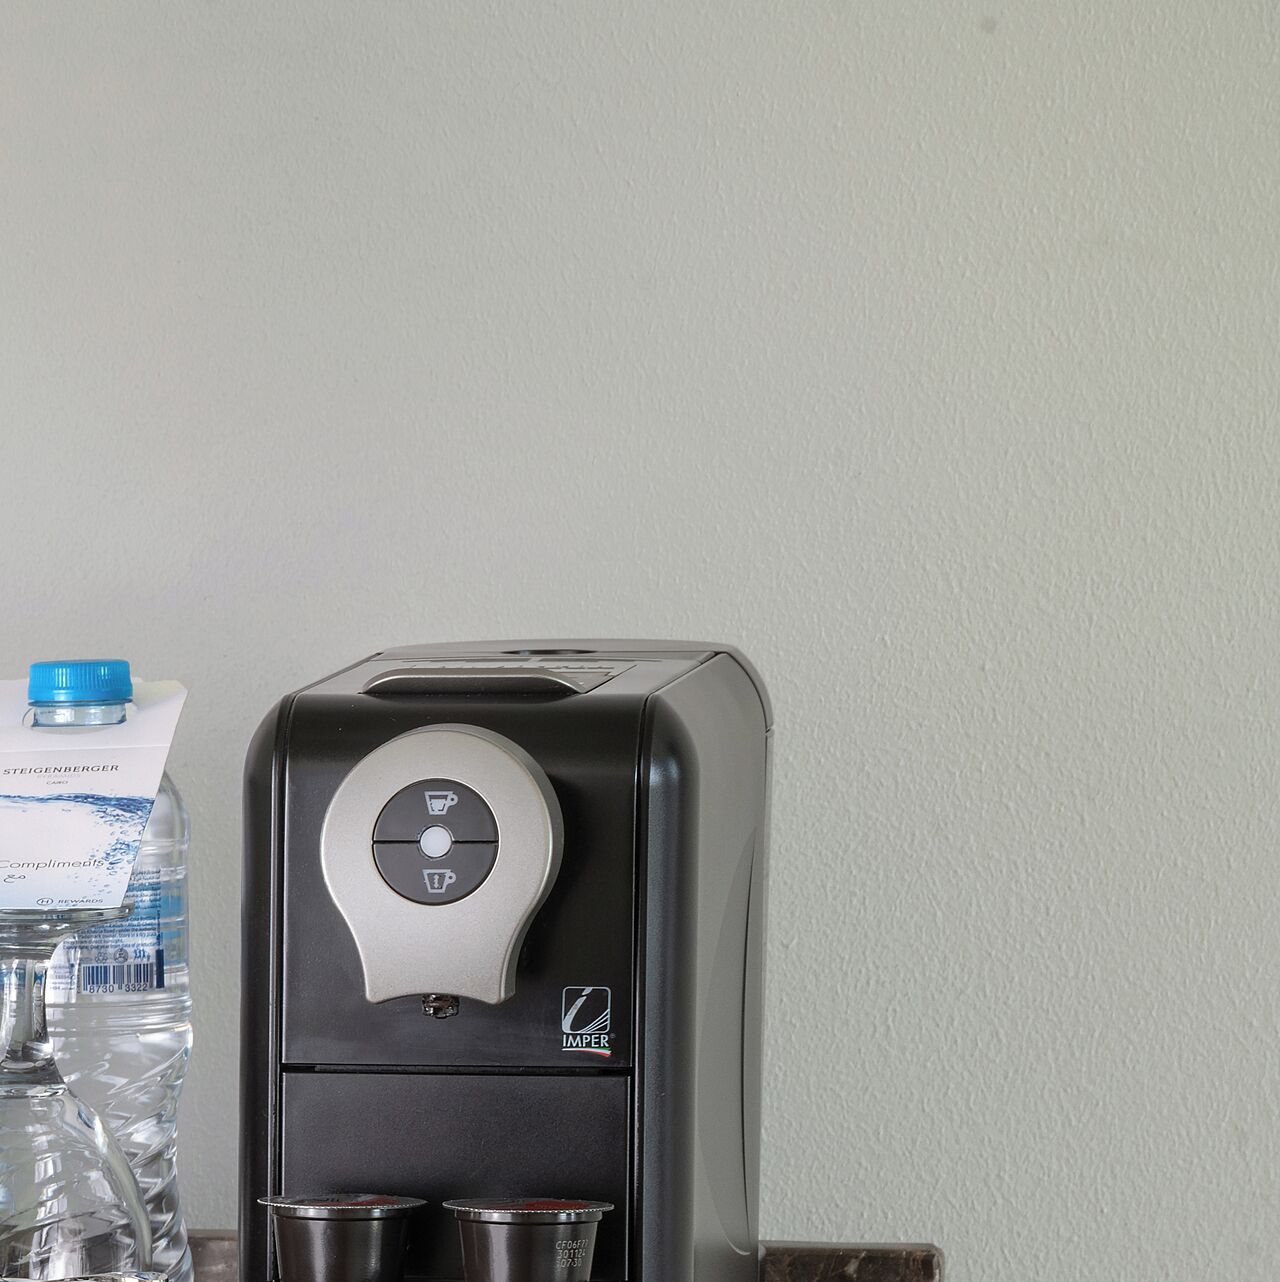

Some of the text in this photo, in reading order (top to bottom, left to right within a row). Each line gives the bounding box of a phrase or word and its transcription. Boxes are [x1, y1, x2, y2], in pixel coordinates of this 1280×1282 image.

[3, 765, 120, 775] STEIGENBERGER
[3, 874, 26, 883] مع
[88, 984, 115, 993] 8730
[124, 983, 148, 992] 3322
[562, 1034, 609, 1047] IMPER
